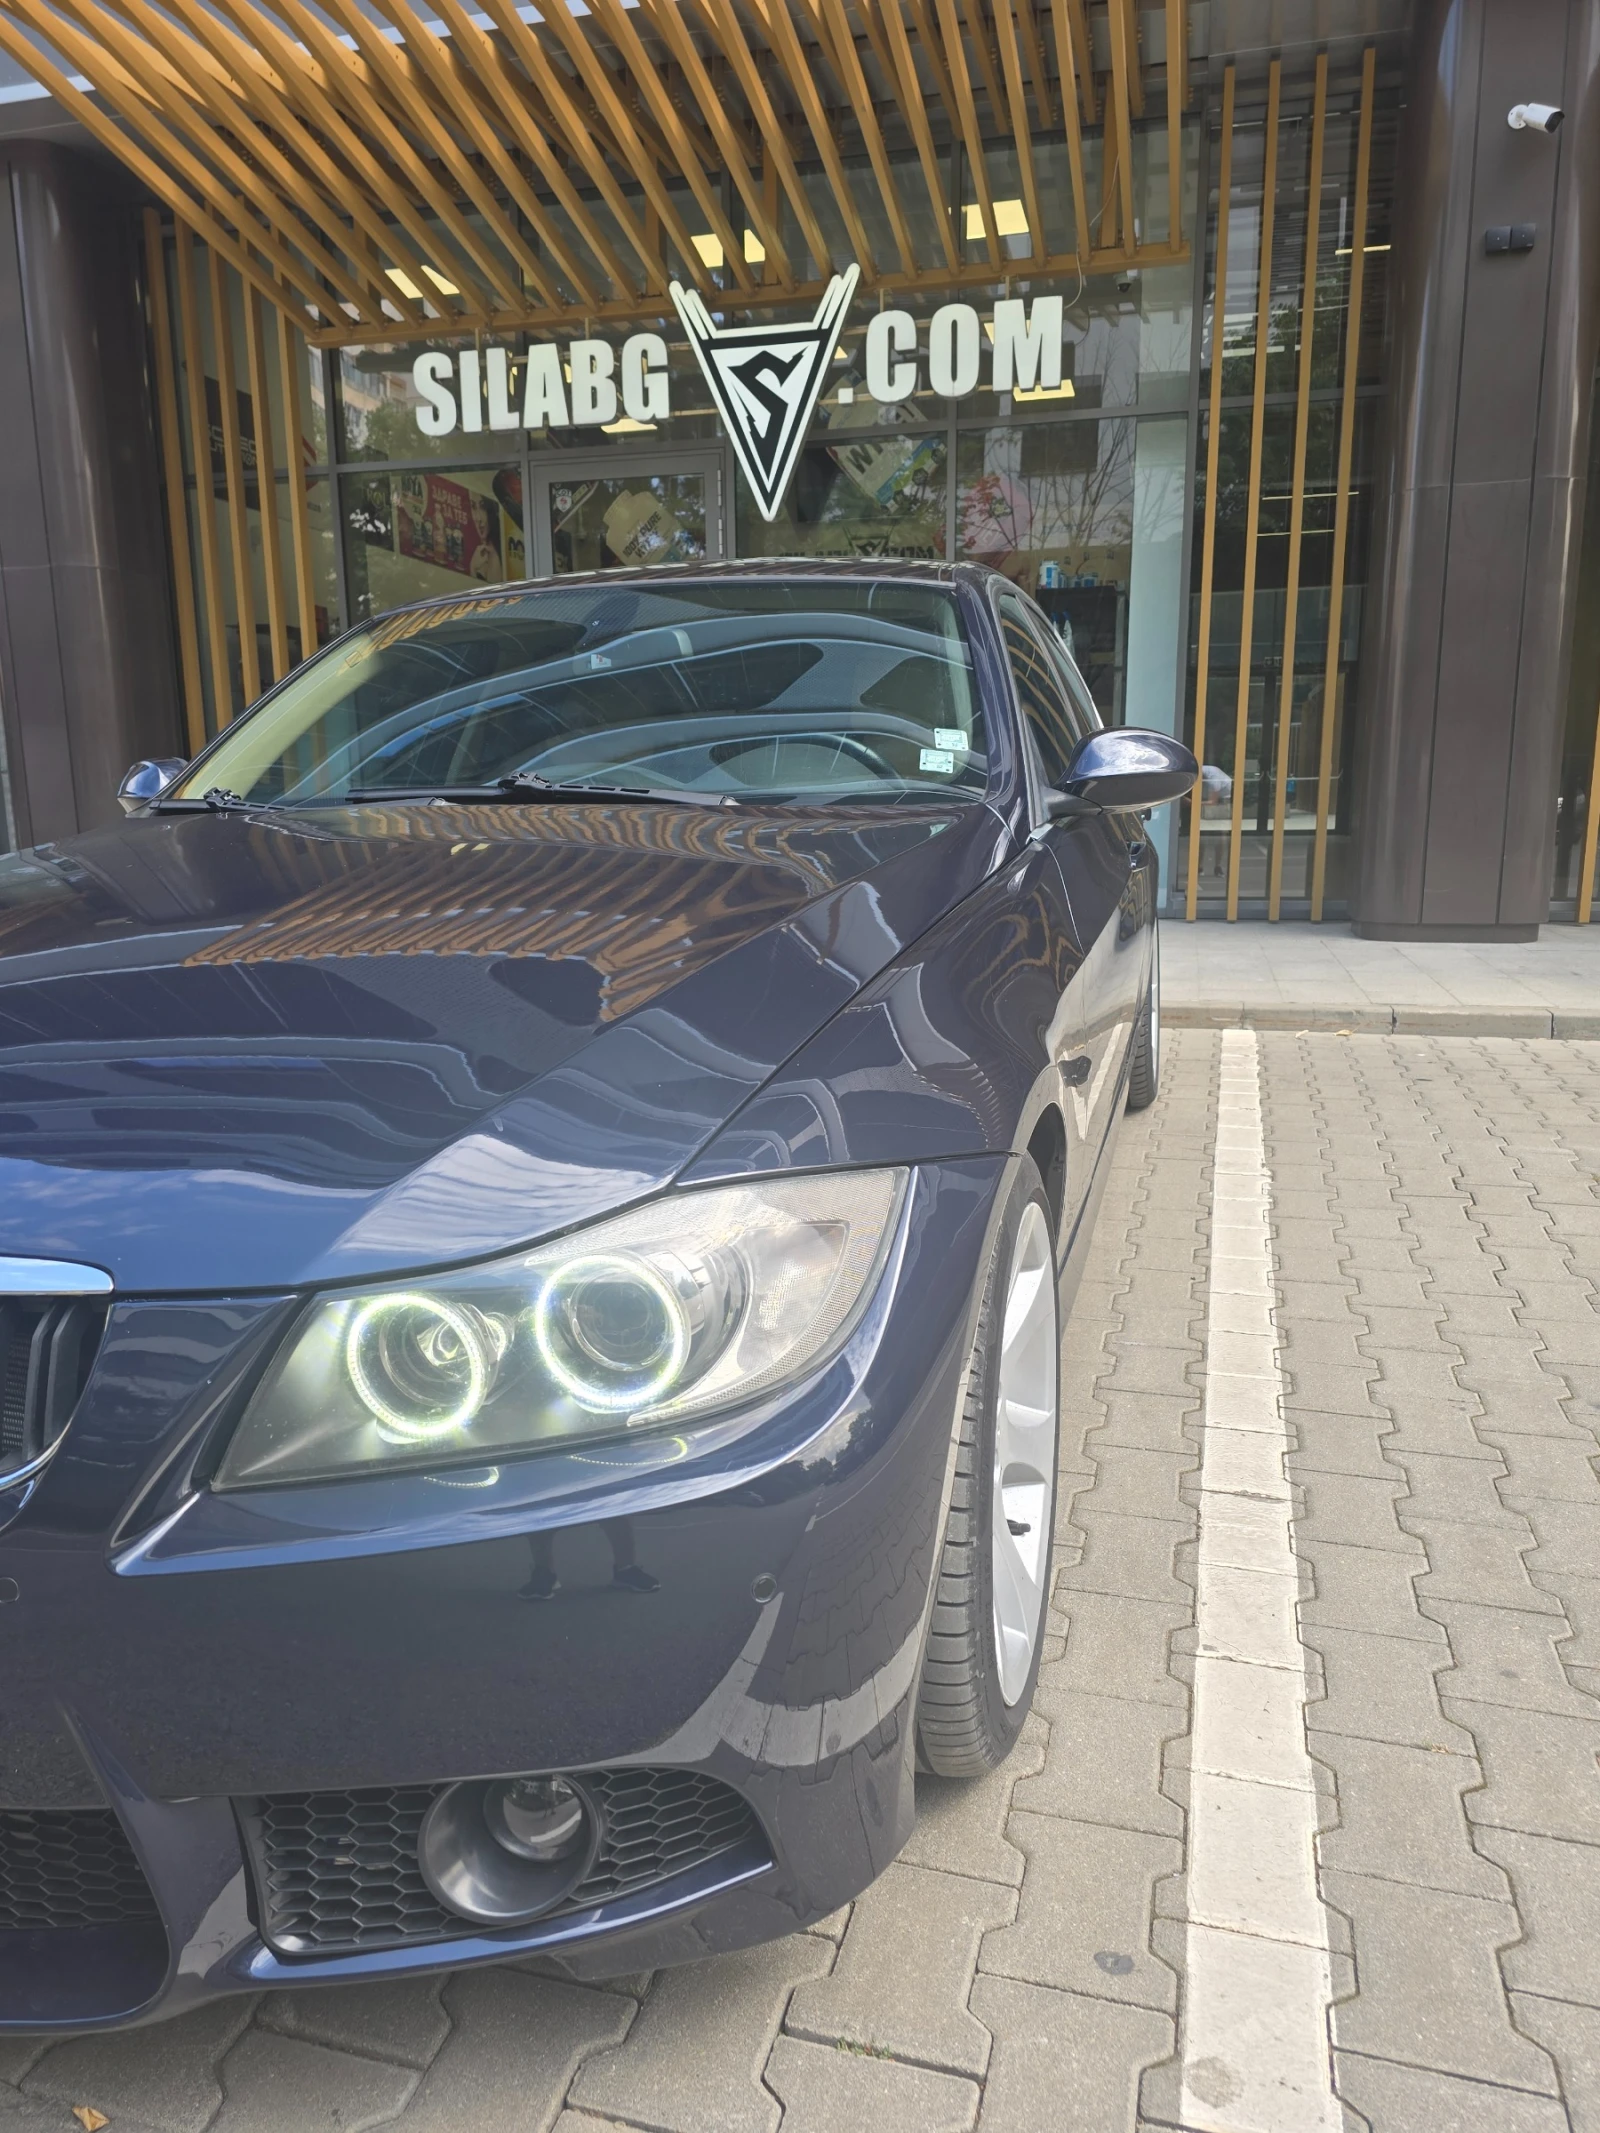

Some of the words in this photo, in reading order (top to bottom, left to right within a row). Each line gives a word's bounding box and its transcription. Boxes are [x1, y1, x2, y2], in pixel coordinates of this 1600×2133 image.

[412, 333, 670, 438] SILABG
[838, 295, 1064, 404] .COM
[639, 511, 662, 536] PURE
